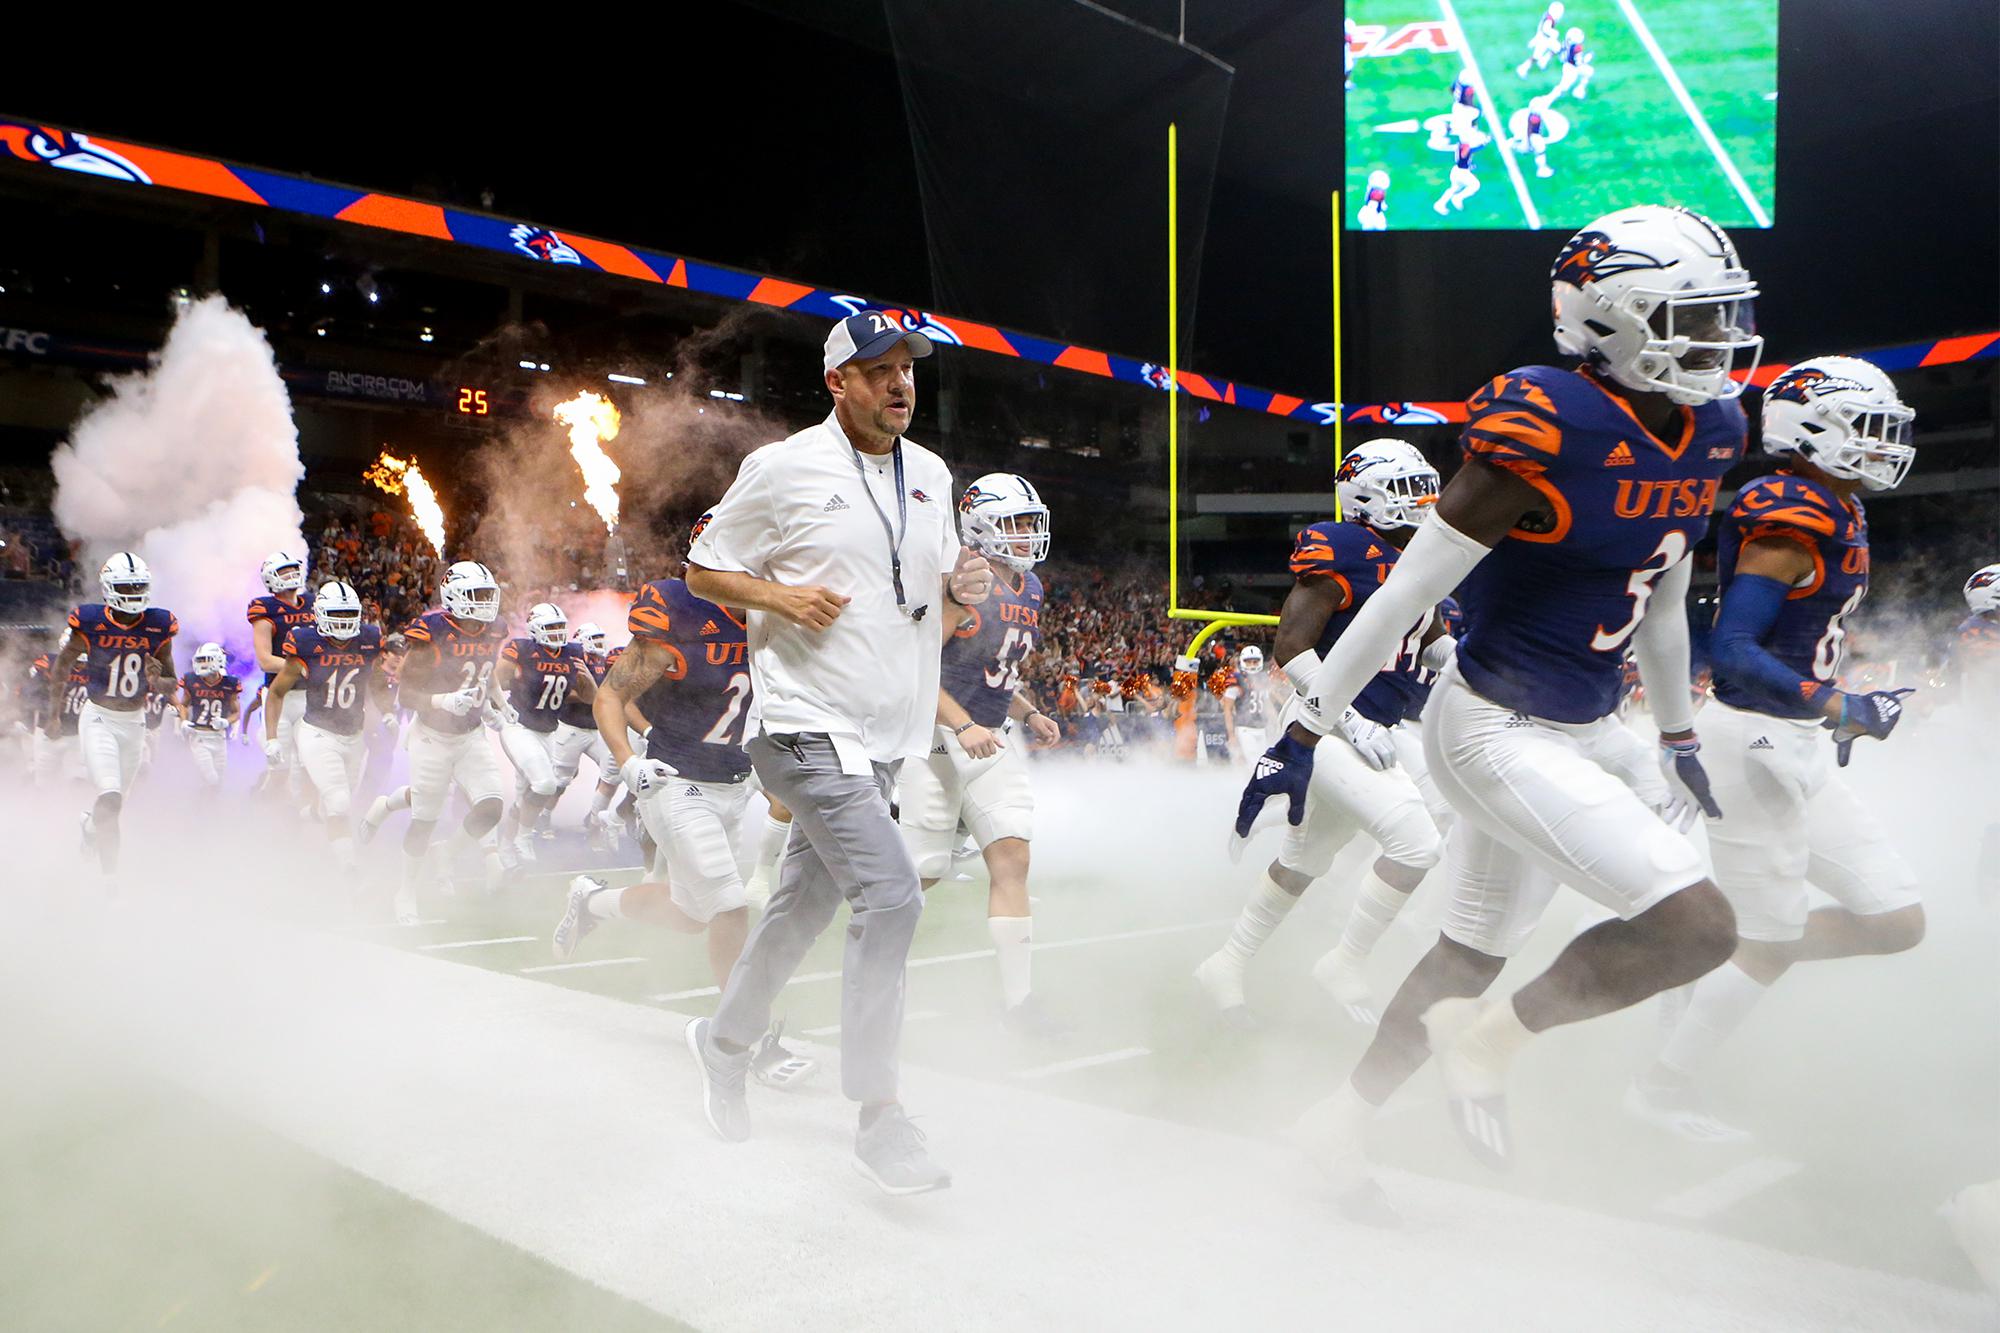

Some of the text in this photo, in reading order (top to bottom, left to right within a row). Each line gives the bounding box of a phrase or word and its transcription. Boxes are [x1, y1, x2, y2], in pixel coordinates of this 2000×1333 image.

[0, 326, 50, 354] FC
[327, 371, 425, 395] ANCIRA.COM
[459, 388, 488, 415] 25
[1604, 456, 1636, 467] adidas
[823, 503, 850, 512] adidas
[1614, 478, 1721, 519] UTSA
[1590, 529, 1688, 651] 3
[1000, 602, 1039, 629] UTSA
[98, 634, 151, 649] UTSA
[453, 641, 495, 657] UTSA
[705, 641, 749, 666] UT
[320, 653, 366, 667] UTSA
[537, 661, 571, 673] UTSA
[105, 653, 142, 698] 18
[323, 667, 360, 709] 16
[535, 675, 568, 711] 78
[702, 672, 751, 746] 2
